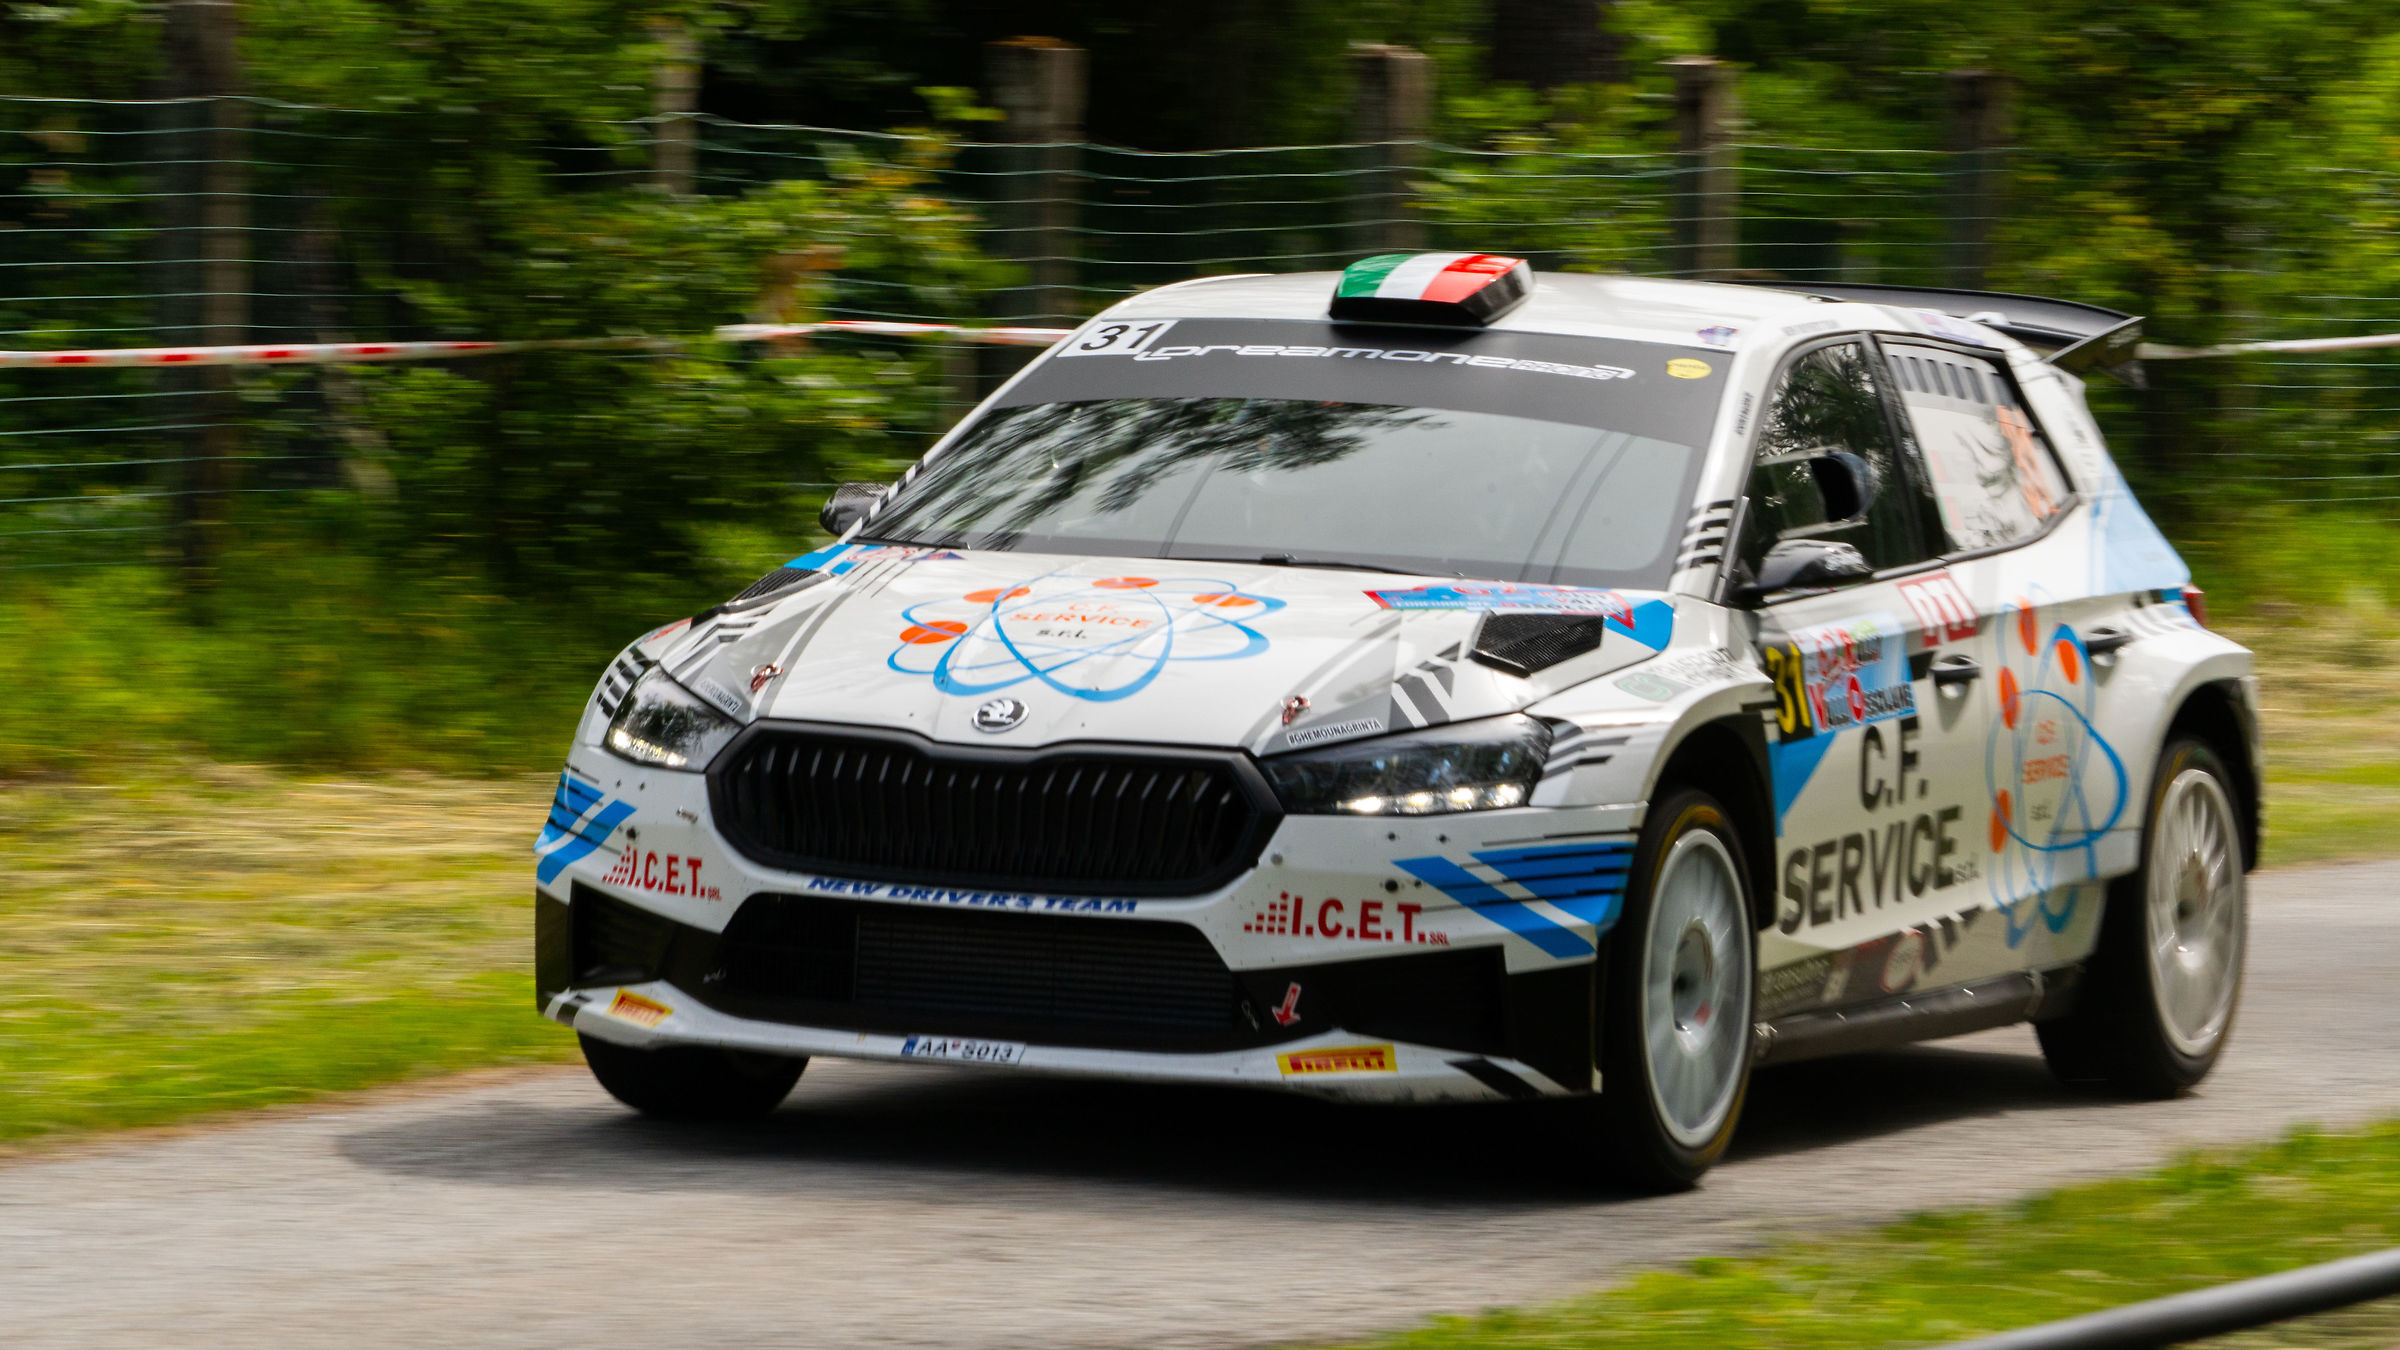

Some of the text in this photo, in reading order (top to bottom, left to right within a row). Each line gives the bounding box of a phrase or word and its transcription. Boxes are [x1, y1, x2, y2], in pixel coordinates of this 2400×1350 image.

[1080, 321, 1166, 351] 31
[1008, 612, 1155, 630] SERVICE
[1766, 640, 1812, 735] 31
[1860, 714, 1929, 812] C.F.
[627, 847, 706, 899] I.C.E.T.
[1778, 803, 1964, 936] SERVICE
[806, 876, 1140, 915] NEW DRIVER'S TEAM
[1291, 895, 1451, 946] I.C.E.T. SRL
[917, 1036, 948, 1058] AA
[1289, 1049, 1386, 1074] PIRELLI
